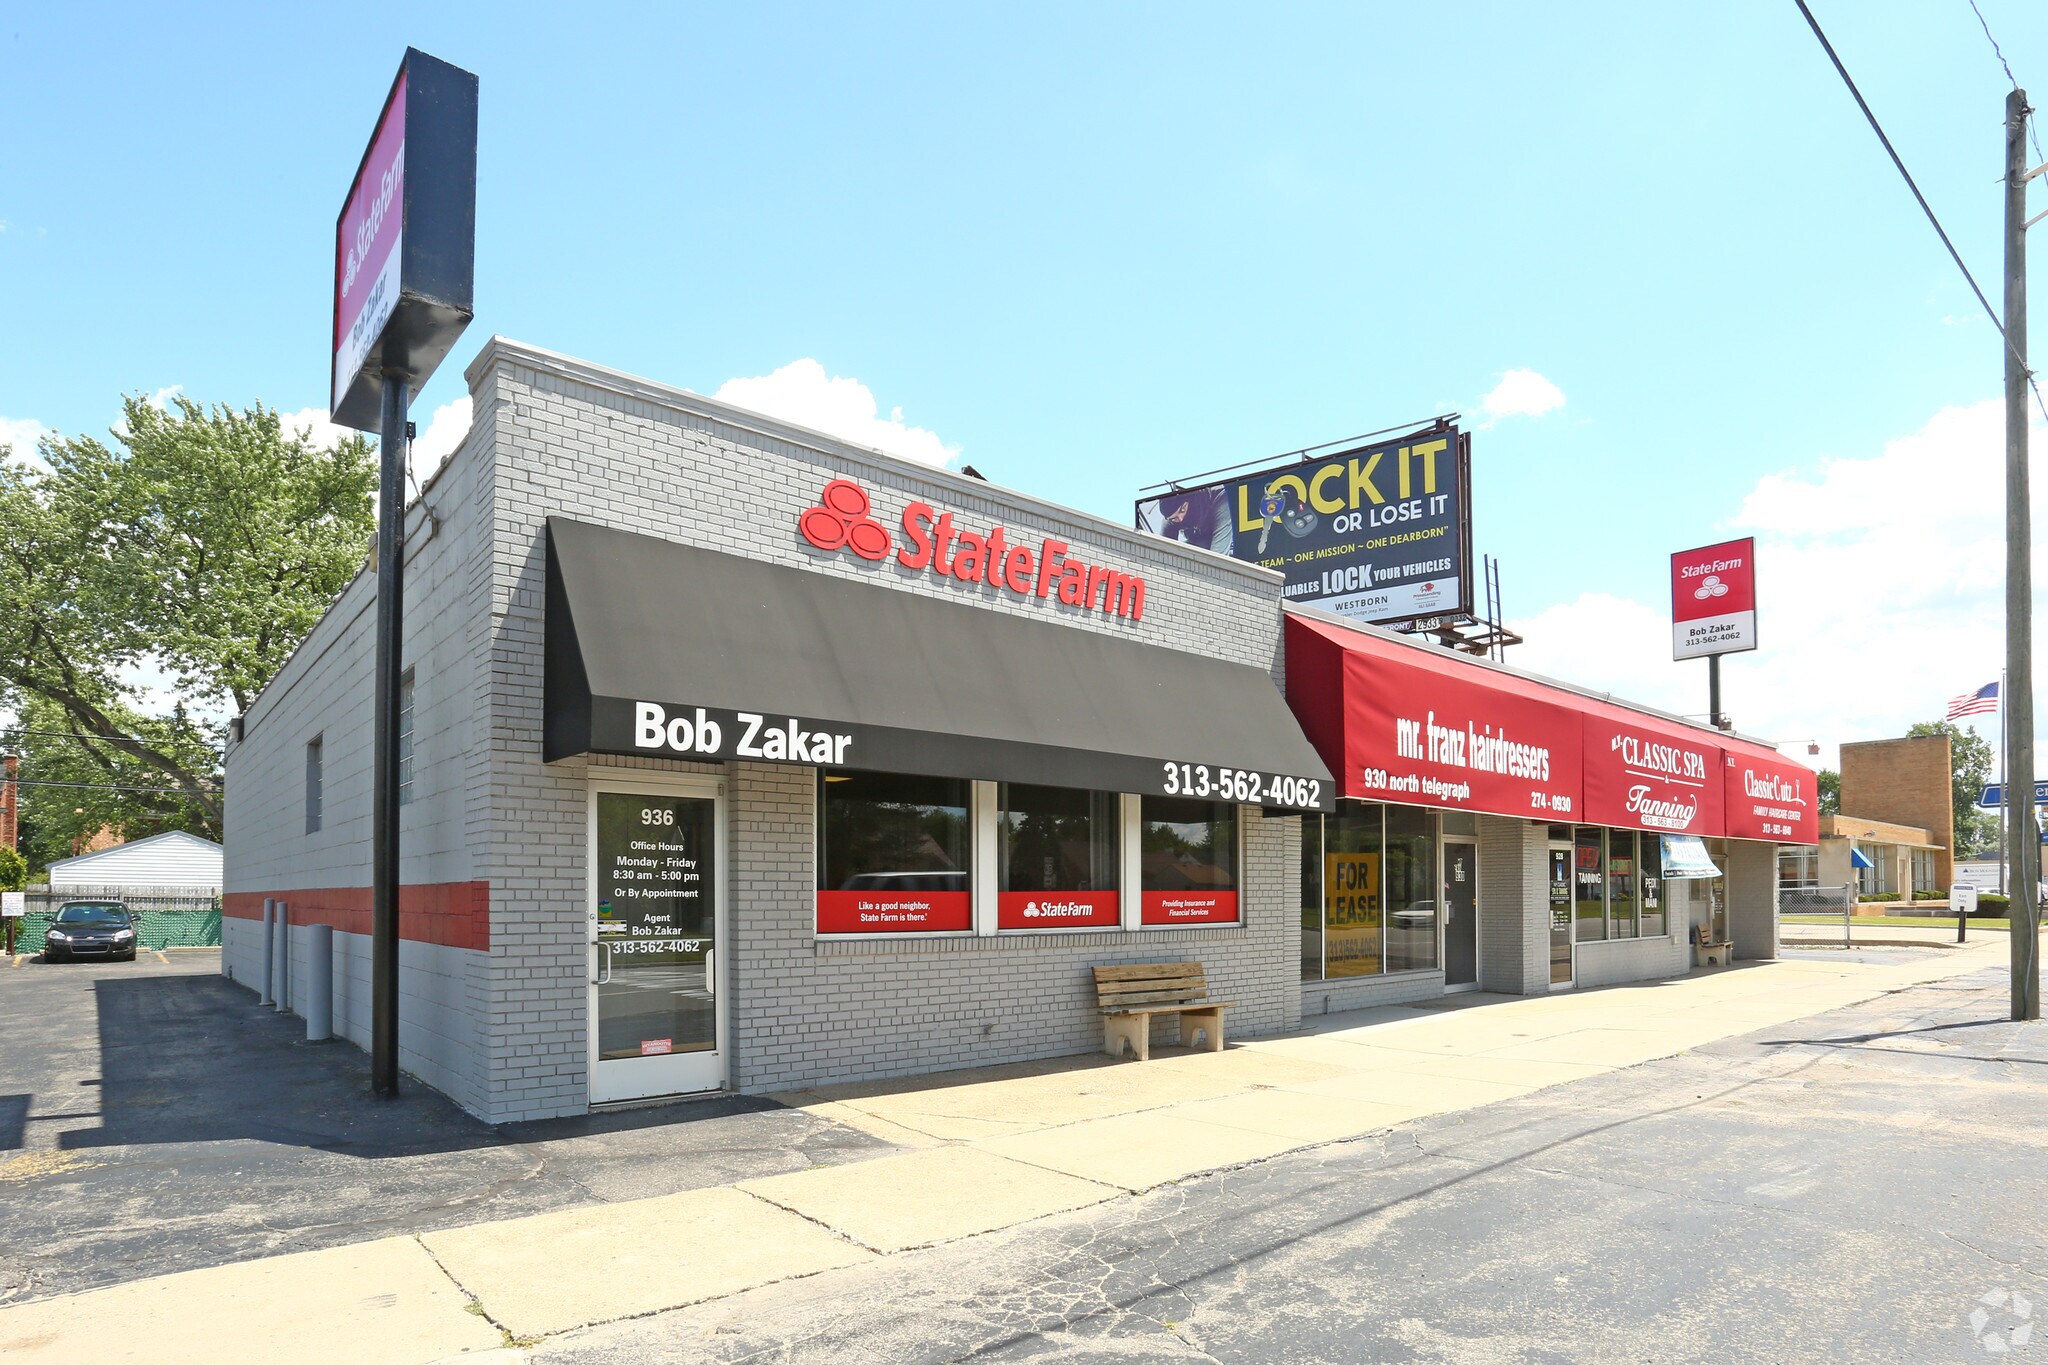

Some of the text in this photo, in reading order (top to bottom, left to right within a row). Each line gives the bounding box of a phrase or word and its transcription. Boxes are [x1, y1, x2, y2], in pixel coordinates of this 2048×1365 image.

[1398, 438, 1447, 499] IT
[1333, 494, 1448, 535] OR LOSE IT
[1260, 556, 1284, 568] TEAM
[1294, 551, 1314, 563] ONE
[1316, 543, 1355, 558] MISSION
[1366, 537, 1388, 549] ONE
[1280, 557, 1451, 598] LUABLES LOCK YOUR VEHICLES
[1335, 595, 1389, 611] WESTBORN
[1690, 623, 1736, 637] Bob Zakar
[1685, 632, 1741, 646] 313-562-4062
[635, 701, 852, 765] Bob Zakar
[1396, 710, 1549, 782] mr. franz hairdressers
[1622, 736, 1682, 775] CLASSIC
[1683, 751, 1706, 779] SPA
[1163, 761, 1321, 808] 313-562-4062
[1364, 768, 1470, 802] 930 north telegraph
[1745, 769, 1774, 800] Classic
[1626, 784, 1698, 821] Tanning
[641, 808, 674, 826] 936
[1753, 804, 1768, 817] FAMILY
[1787, 810, 1801, 821] CENTER
[630, 840, 684, 851] Office Hours
[616, 856, 658, 868] Monday
[666, 858, 697, 870] Friday
[613, 870, 634, 880] 8:30
[637, 872, 653, 880] am
[661, 870, 682, 880] 5:00
[683, 873, 700, 882] pm
[1336, 862, 1368, 890] FOR
[1578, 872, 1602, 884] TANNING
[614, 888, 699, 899] Or By Appointment
[858, 901, 874, 910] Like
[881, 901, 898, 912] good
[899, 901, 931, 912] neighbor,
[1040, 901, 1093, 917] StateFarm
[1162, 900, 1184, 908] Providing
[1184, 899, 1206, 907] Insurance
[1326, 895, 1376, 925] LEASE
[643, 913, 671, 924] Agent
[860, 913, 879, 922] State
[880, 913, 898, 922] Farm
[899, 913, 905, 921] is
[1190, 908, 1209, 916] Services
[632, 926, 682, 936] Bob Zakar
[613, 941, 700, 954] 313-562-4062
